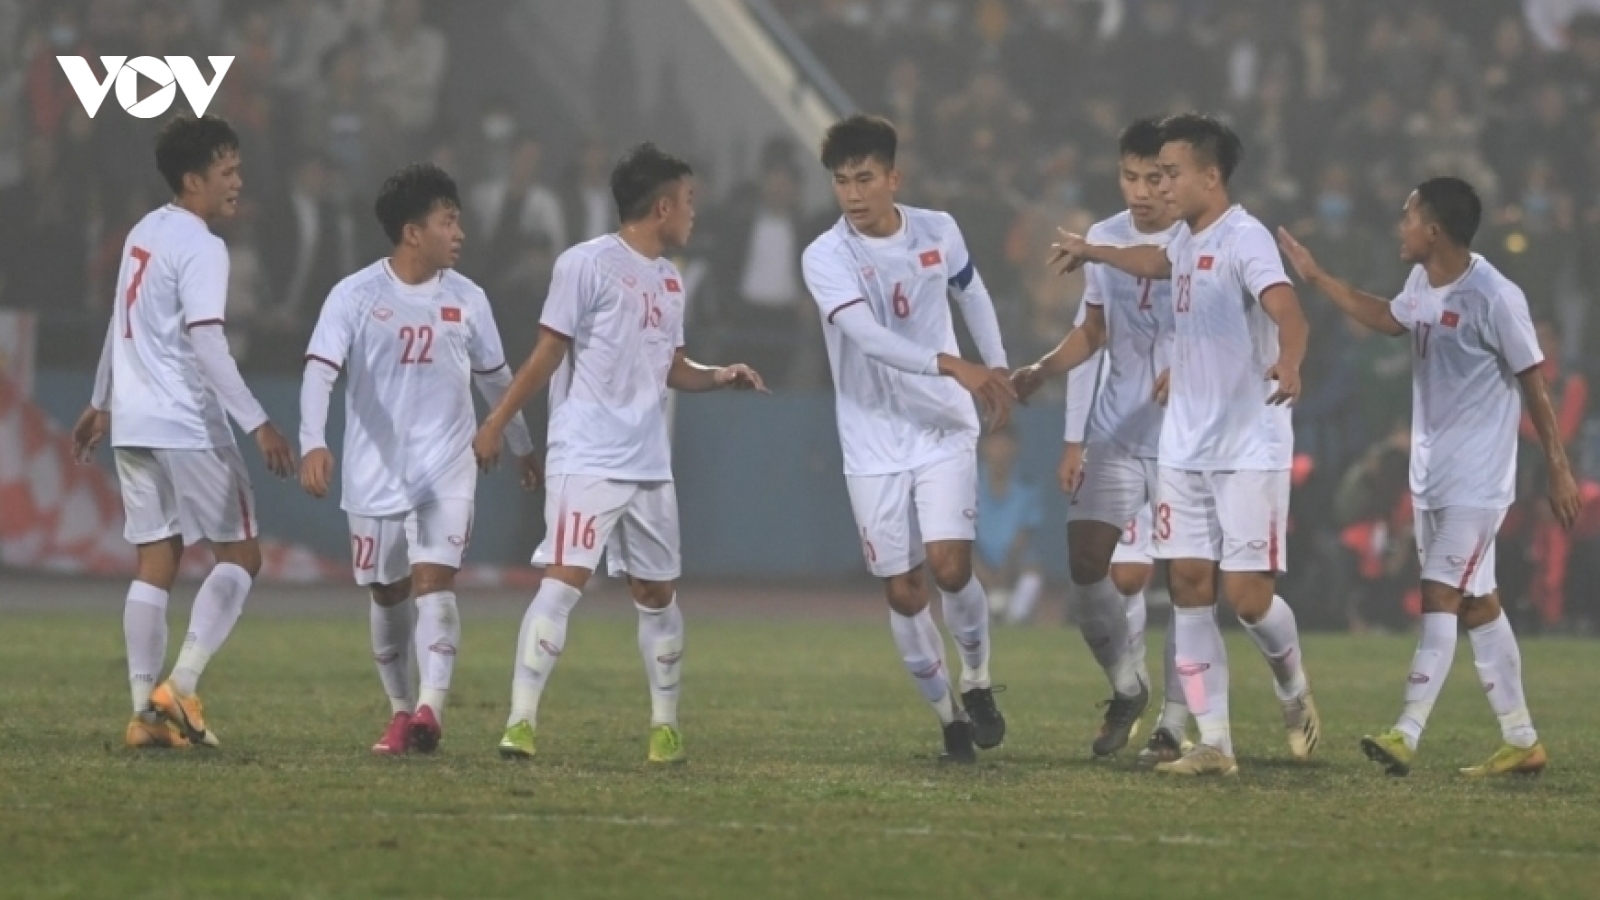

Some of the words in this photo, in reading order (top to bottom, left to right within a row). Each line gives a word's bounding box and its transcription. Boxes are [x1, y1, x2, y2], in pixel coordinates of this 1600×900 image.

[125, 246, 151, 338] 7
[893, 281, 910, 318] 6
[1176, 274, 1190, 312] 23
[400, 326, 433, 364] 22
[572, 511, 597, 549] 16
